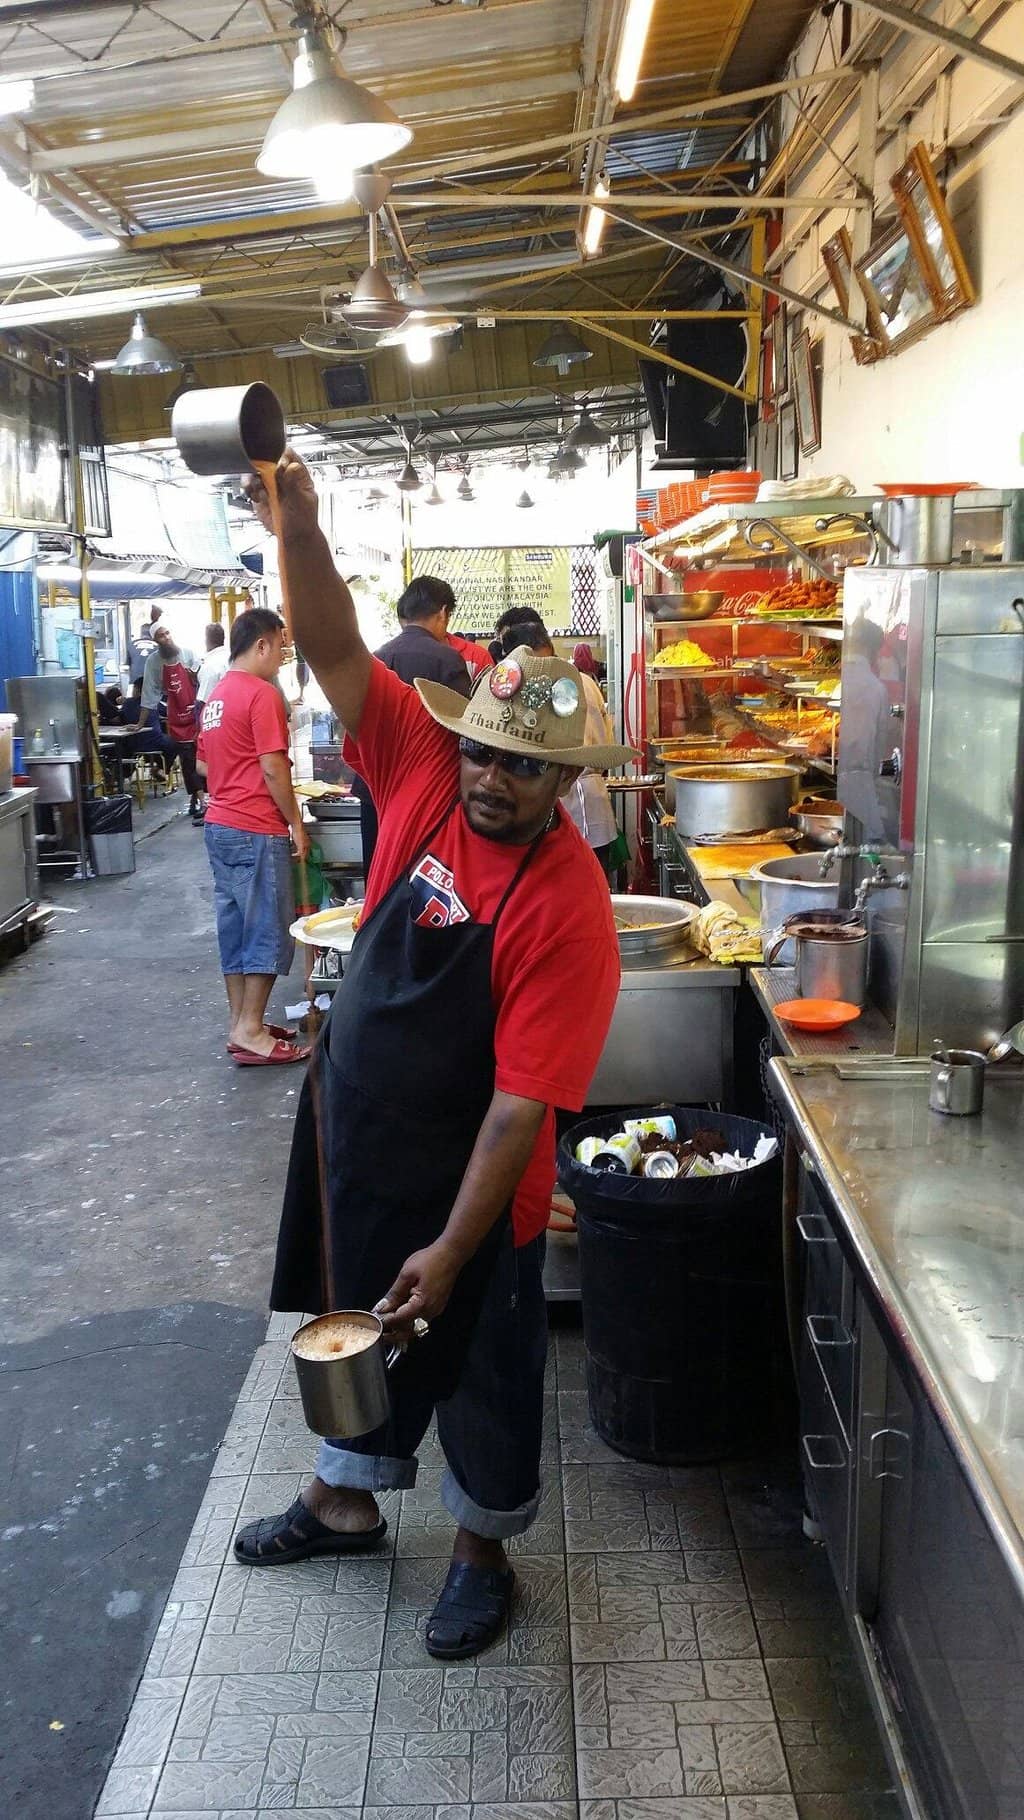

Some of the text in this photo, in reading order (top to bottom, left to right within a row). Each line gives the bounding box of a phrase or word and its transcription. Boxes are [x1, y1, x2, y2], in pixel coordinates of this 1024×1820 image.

[499, 584, 516, 593] ARE
[536, 583, 553, 591] ONE
[481, 602, 505, 610] WEST
[539, 609, 557, 617] EST.
[427, 866, 454, 889] POLO
